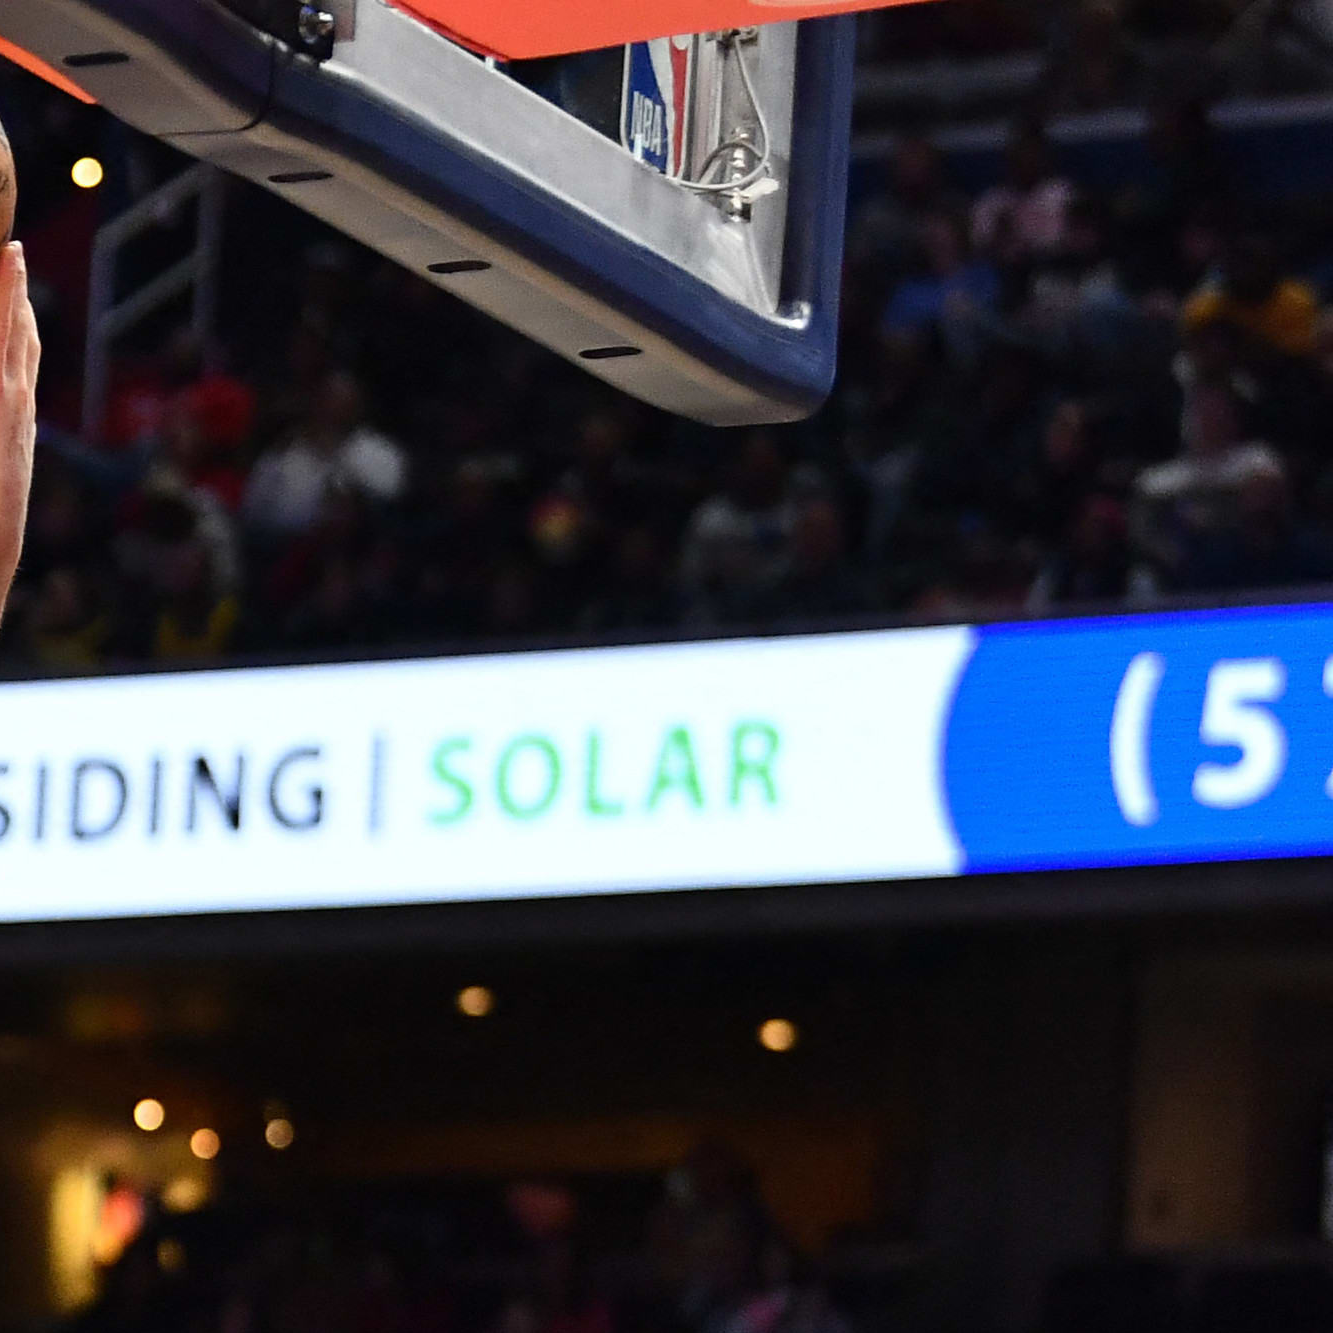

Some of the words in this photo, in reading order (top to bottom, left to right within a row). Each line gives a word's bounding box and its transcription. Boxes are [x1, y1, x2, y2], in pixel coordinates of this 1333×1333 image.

[630, 91, 661, 157] NBA
[427, 720, 784, 826] SOLAR
[1110, 652, 1333, 826] (5
